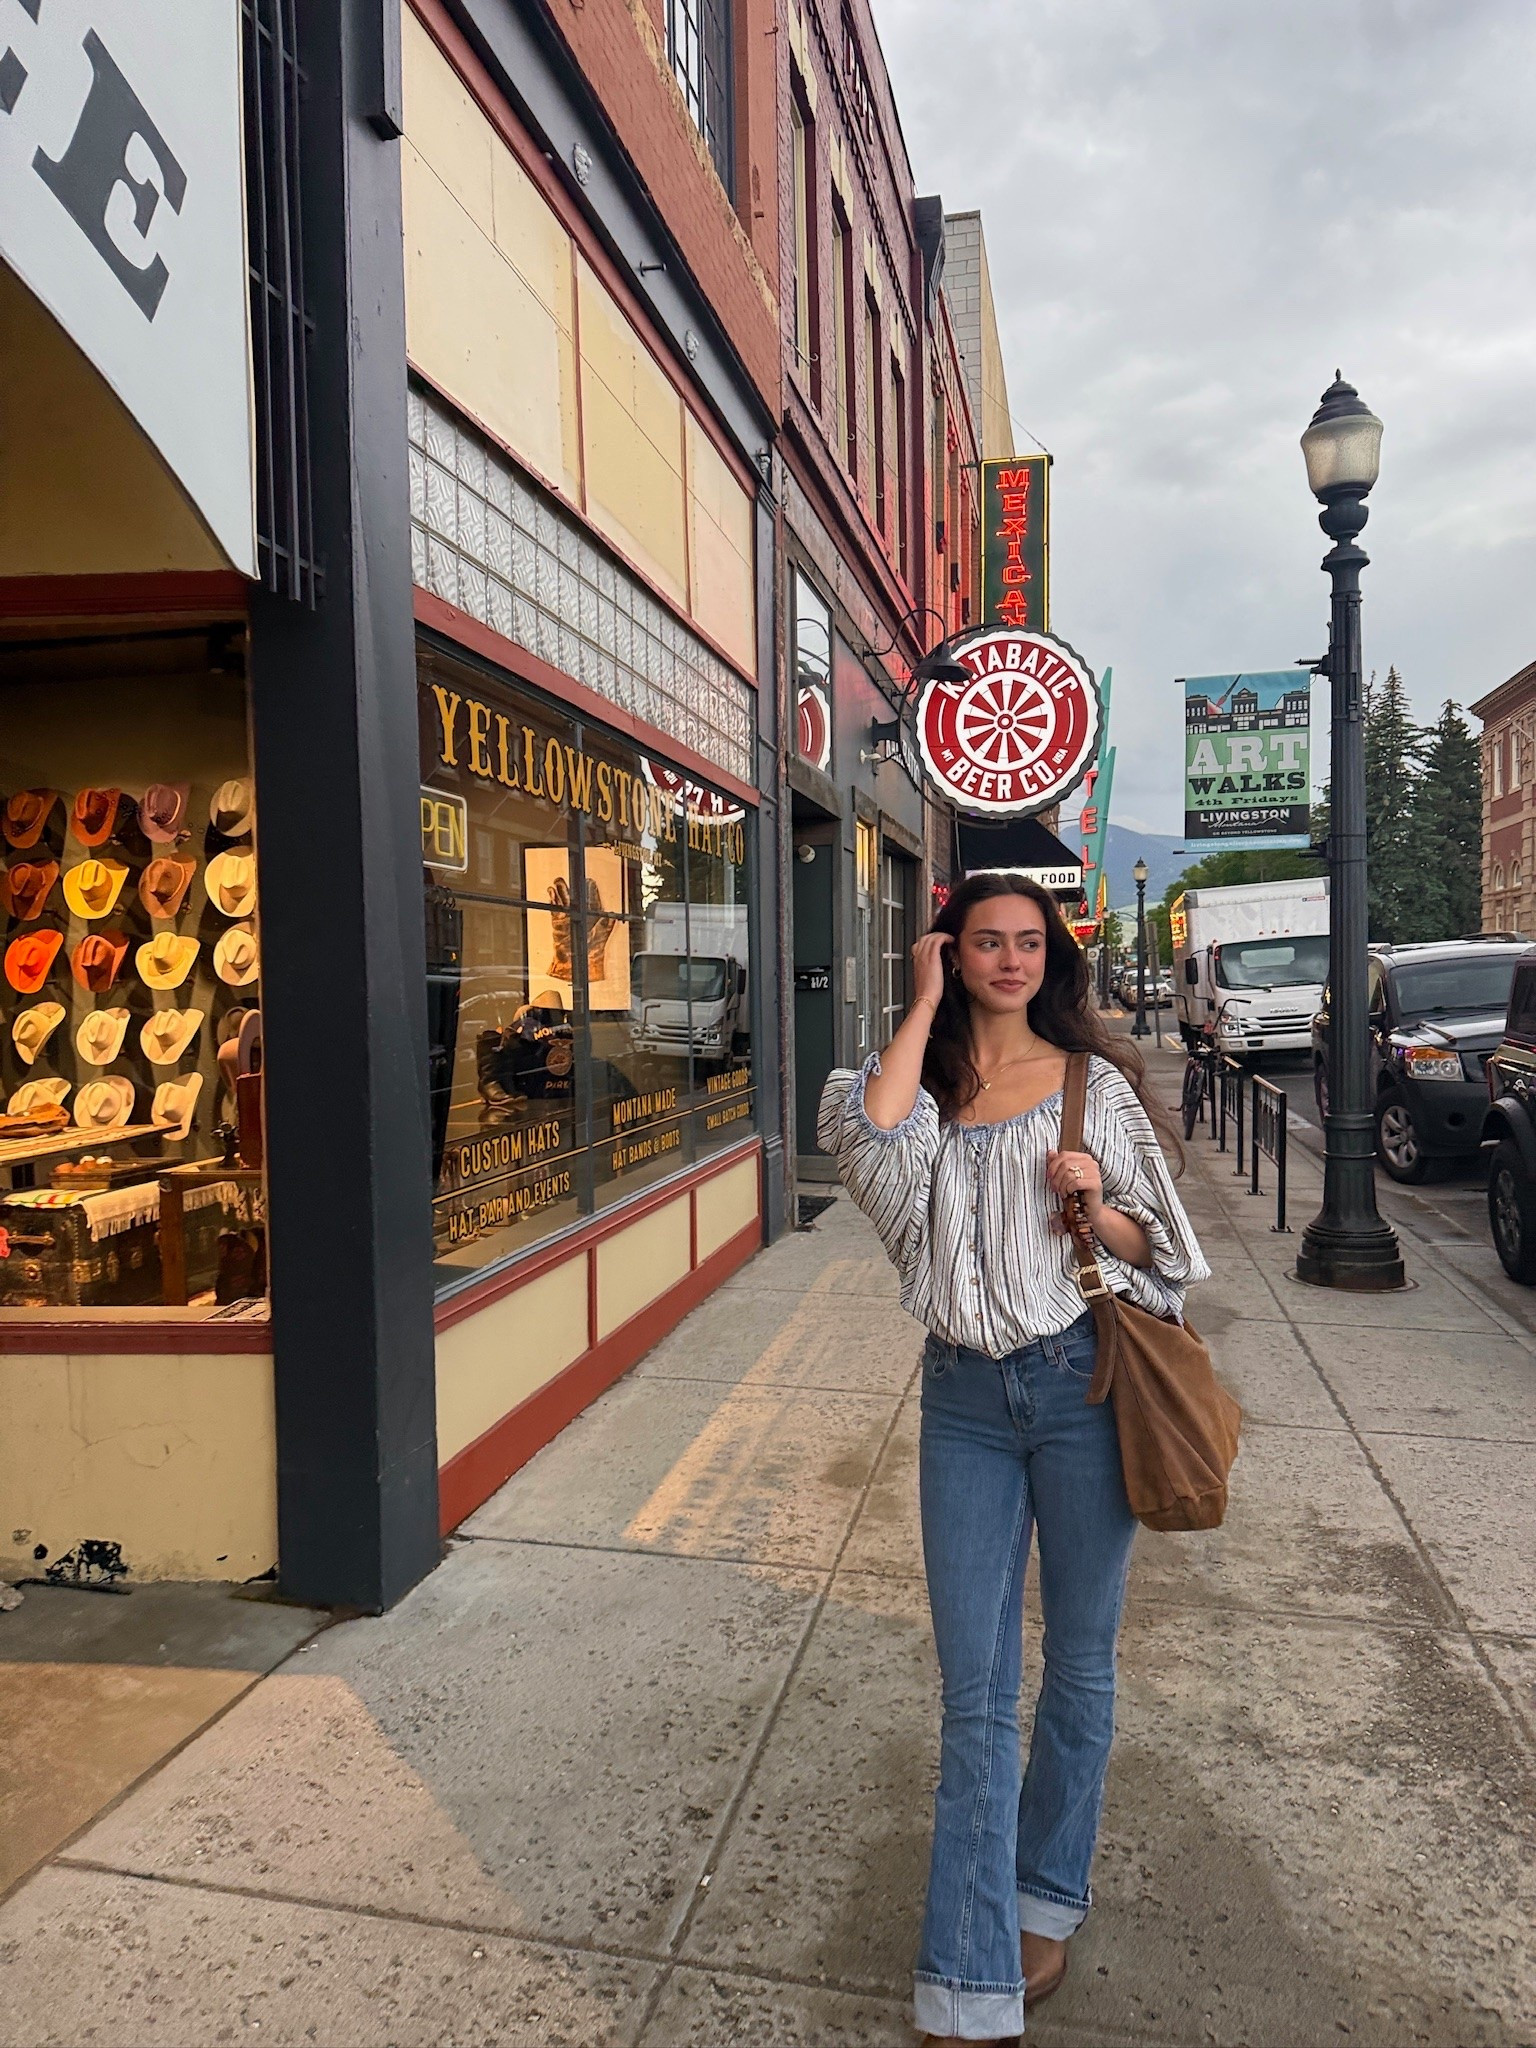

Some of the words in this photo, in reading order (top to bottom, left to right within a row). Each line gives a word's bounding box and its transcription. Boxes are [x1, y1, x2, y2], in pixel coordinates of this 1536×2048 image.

[0, 0, 187, 323] E
[937, 643, 1079, 700] KTABATIC
[941, 748, 954, 762] MT
[1052, 748, 1068, 764] USA
[1187, 733, 1308, 775] ART
[431, 684, 677, 843] YELLOWSTONE
[687, 801, 724, 858] HAT
[726, 820, 744, 866] CO
[946, 757, 1012, 799] BEER
[1019, 760, 1063, 795] CO.
[1189, 772, 1306, 795] WALKS
[1196, 798, 1223, 806] 4th
[1231, 796, 1299, 805] Fridays
[1200, 809, 1290, 823] LIVINGSTON
[1041, 872, 1075, 884] FOOD
[707, 1072, 731, 1095] VINTAGE
[732, 1067, 748, 1088] GOODS
[613, 1094, 652, 1126] MONTANA
[654, 1088, 676, 1113] MADE
[707, 1112, 721, 1130] SMALL
[461, 1131, 521, 1178] CUSTOM
[527, 1120, 560, 1156] HATS
[612, 1149, 627, 1171] HAT
[628, 1139, 652, 1164] BANDS
[661, 1129, 680, 1150] BOOTS
[449, 1208, 474, 1241] HAT
[479, 1197, 503, 1228] BAR
[508, 1187, 531, 1217] AND
[534, 1171, 570, 1205] EVENTS
